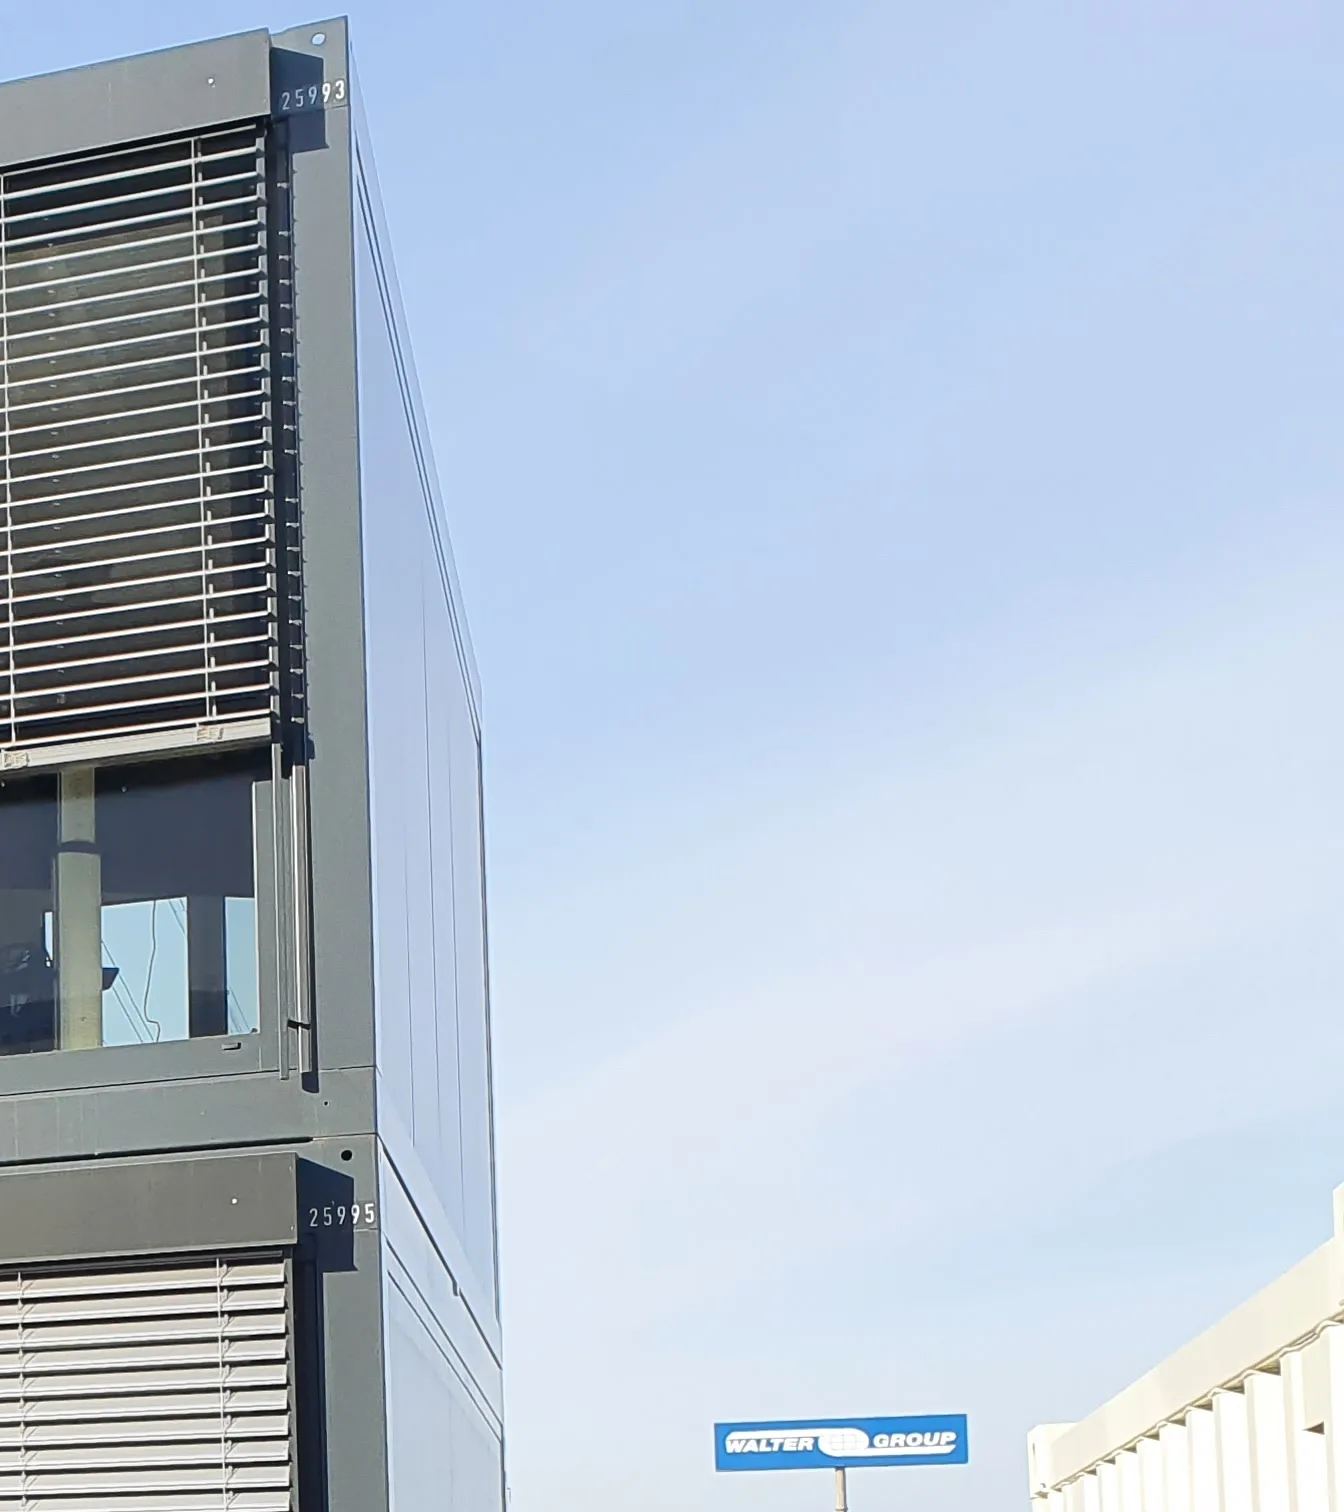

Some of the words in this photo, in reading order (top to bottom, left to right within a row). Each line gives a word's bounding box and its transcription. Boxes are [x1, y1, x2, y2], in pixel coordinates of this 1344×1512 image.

[281, 79, 345, 111] 25993
[309, 1203, 375, 1227] 25995
[726, 1437, 814, 1454] WALTER
[873, 1431, 957, 1448] GROUP
